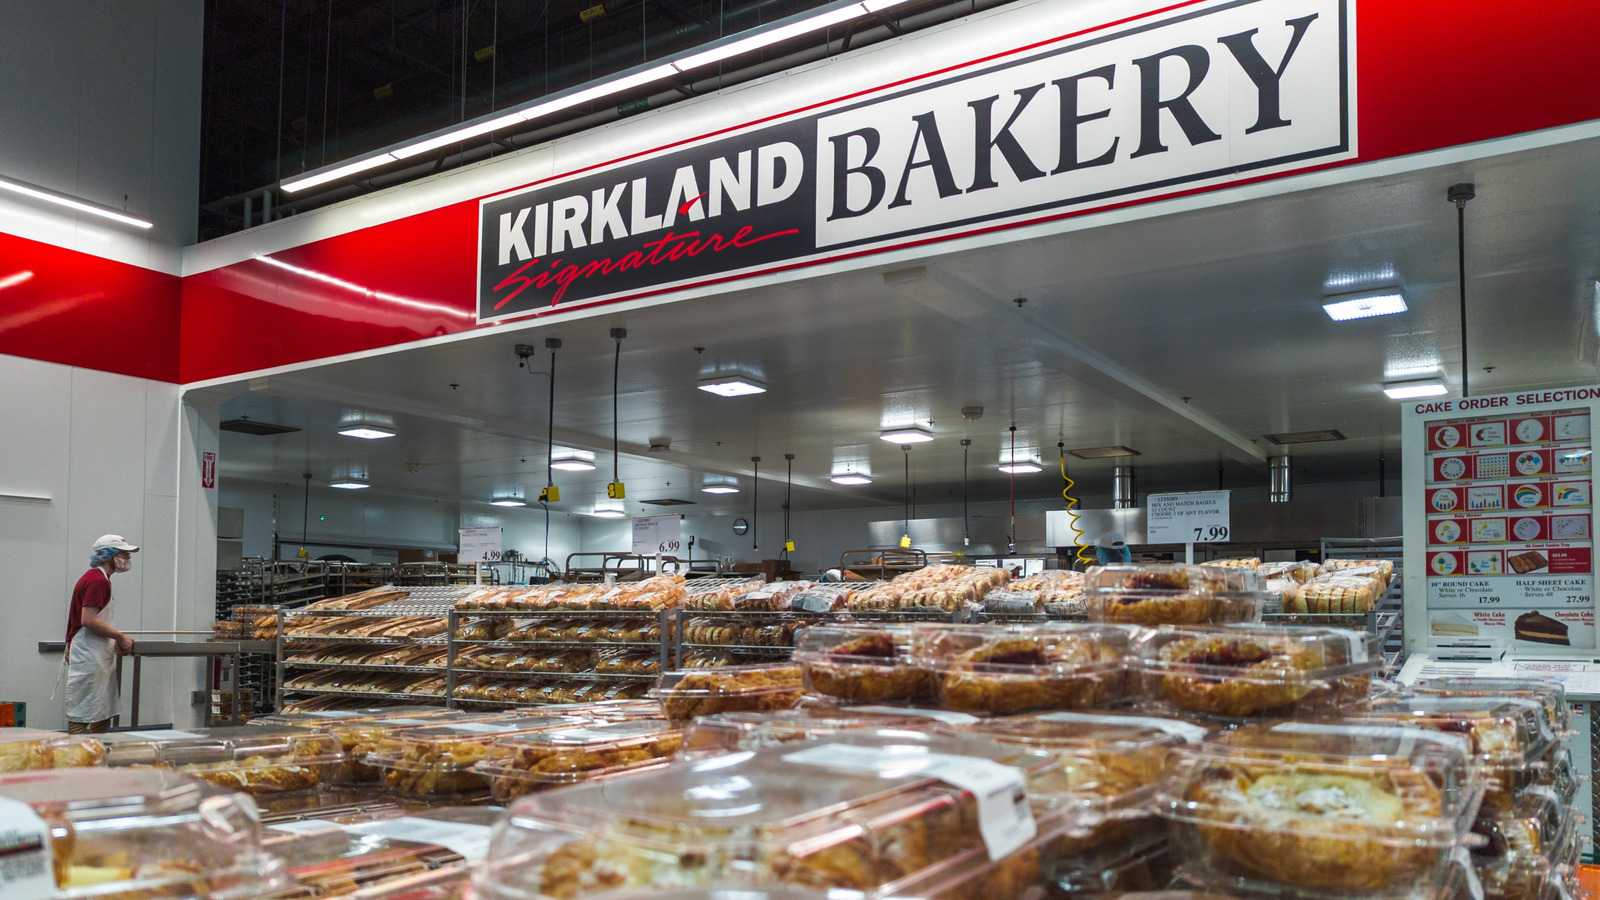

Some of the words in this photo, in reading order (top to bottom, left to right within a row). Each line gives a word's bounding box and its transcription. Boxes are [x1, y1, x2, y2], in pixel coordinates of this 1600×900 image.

[826, 12, 1319, 223] BAKERY
[498, 141, 804, 266] KIRKLAND
[493, 225, 799, 311] Signature
[1415, 402, 1452, 414] CAKE
[1459, 397, 1508, 410] ORDER
[1516, 387, 1600, 405] SELECTION
[659, 540, 680, 552] 6.99
[1194, 526, 1228, 541] 7.99
[483, 551, 500, 560] 4.99
